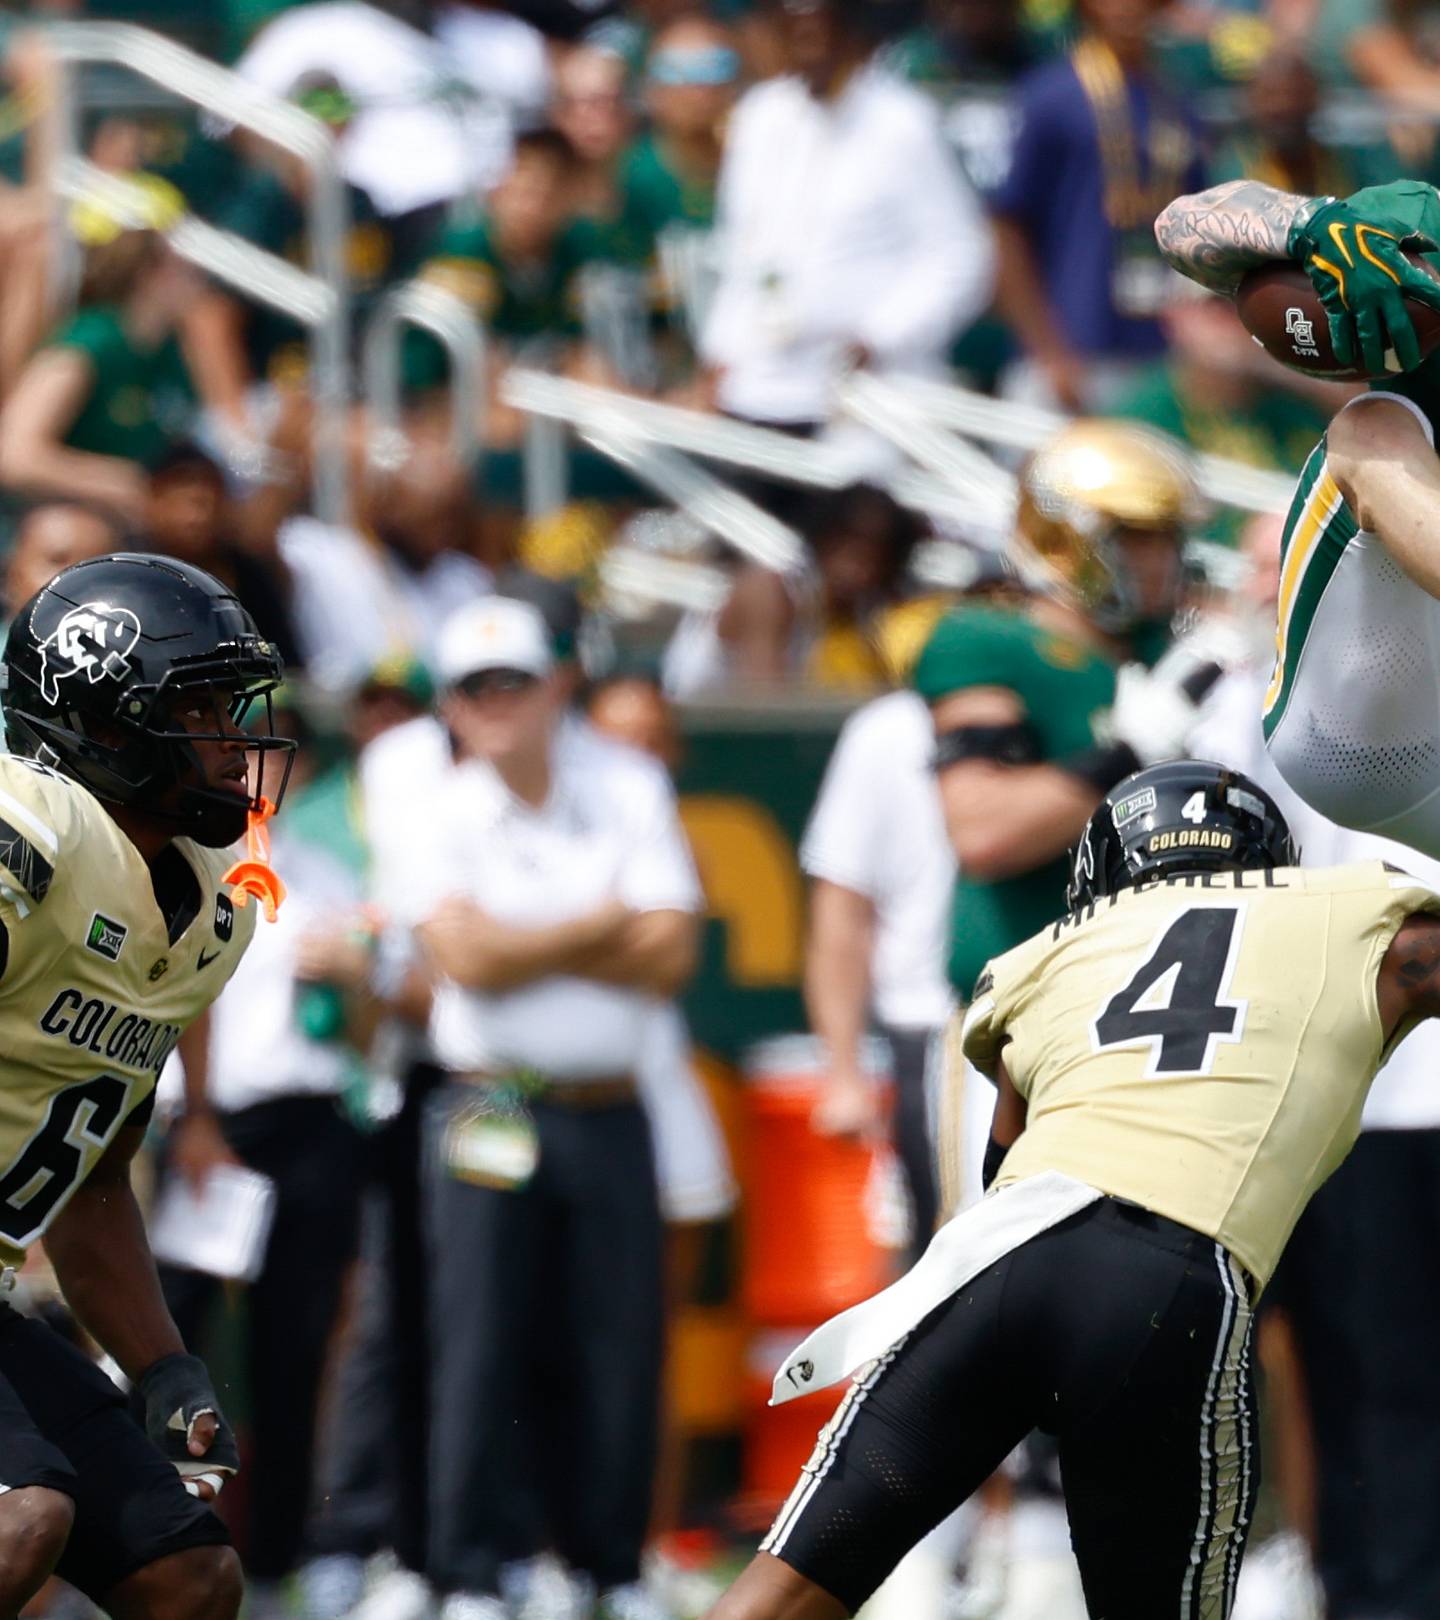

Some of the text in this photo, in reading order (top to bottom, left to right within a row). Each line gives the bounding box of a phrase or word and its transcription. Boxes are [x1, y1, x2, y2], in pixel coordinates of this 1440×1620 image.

[1180, 791, 1207, 824] 4
[1150, 829, 1232, 852] COLORADO
[216, 905, 227, 925] DP
[1094, 905, 1244, 1074] 4
[0, 1073, 131, 1244] 6
